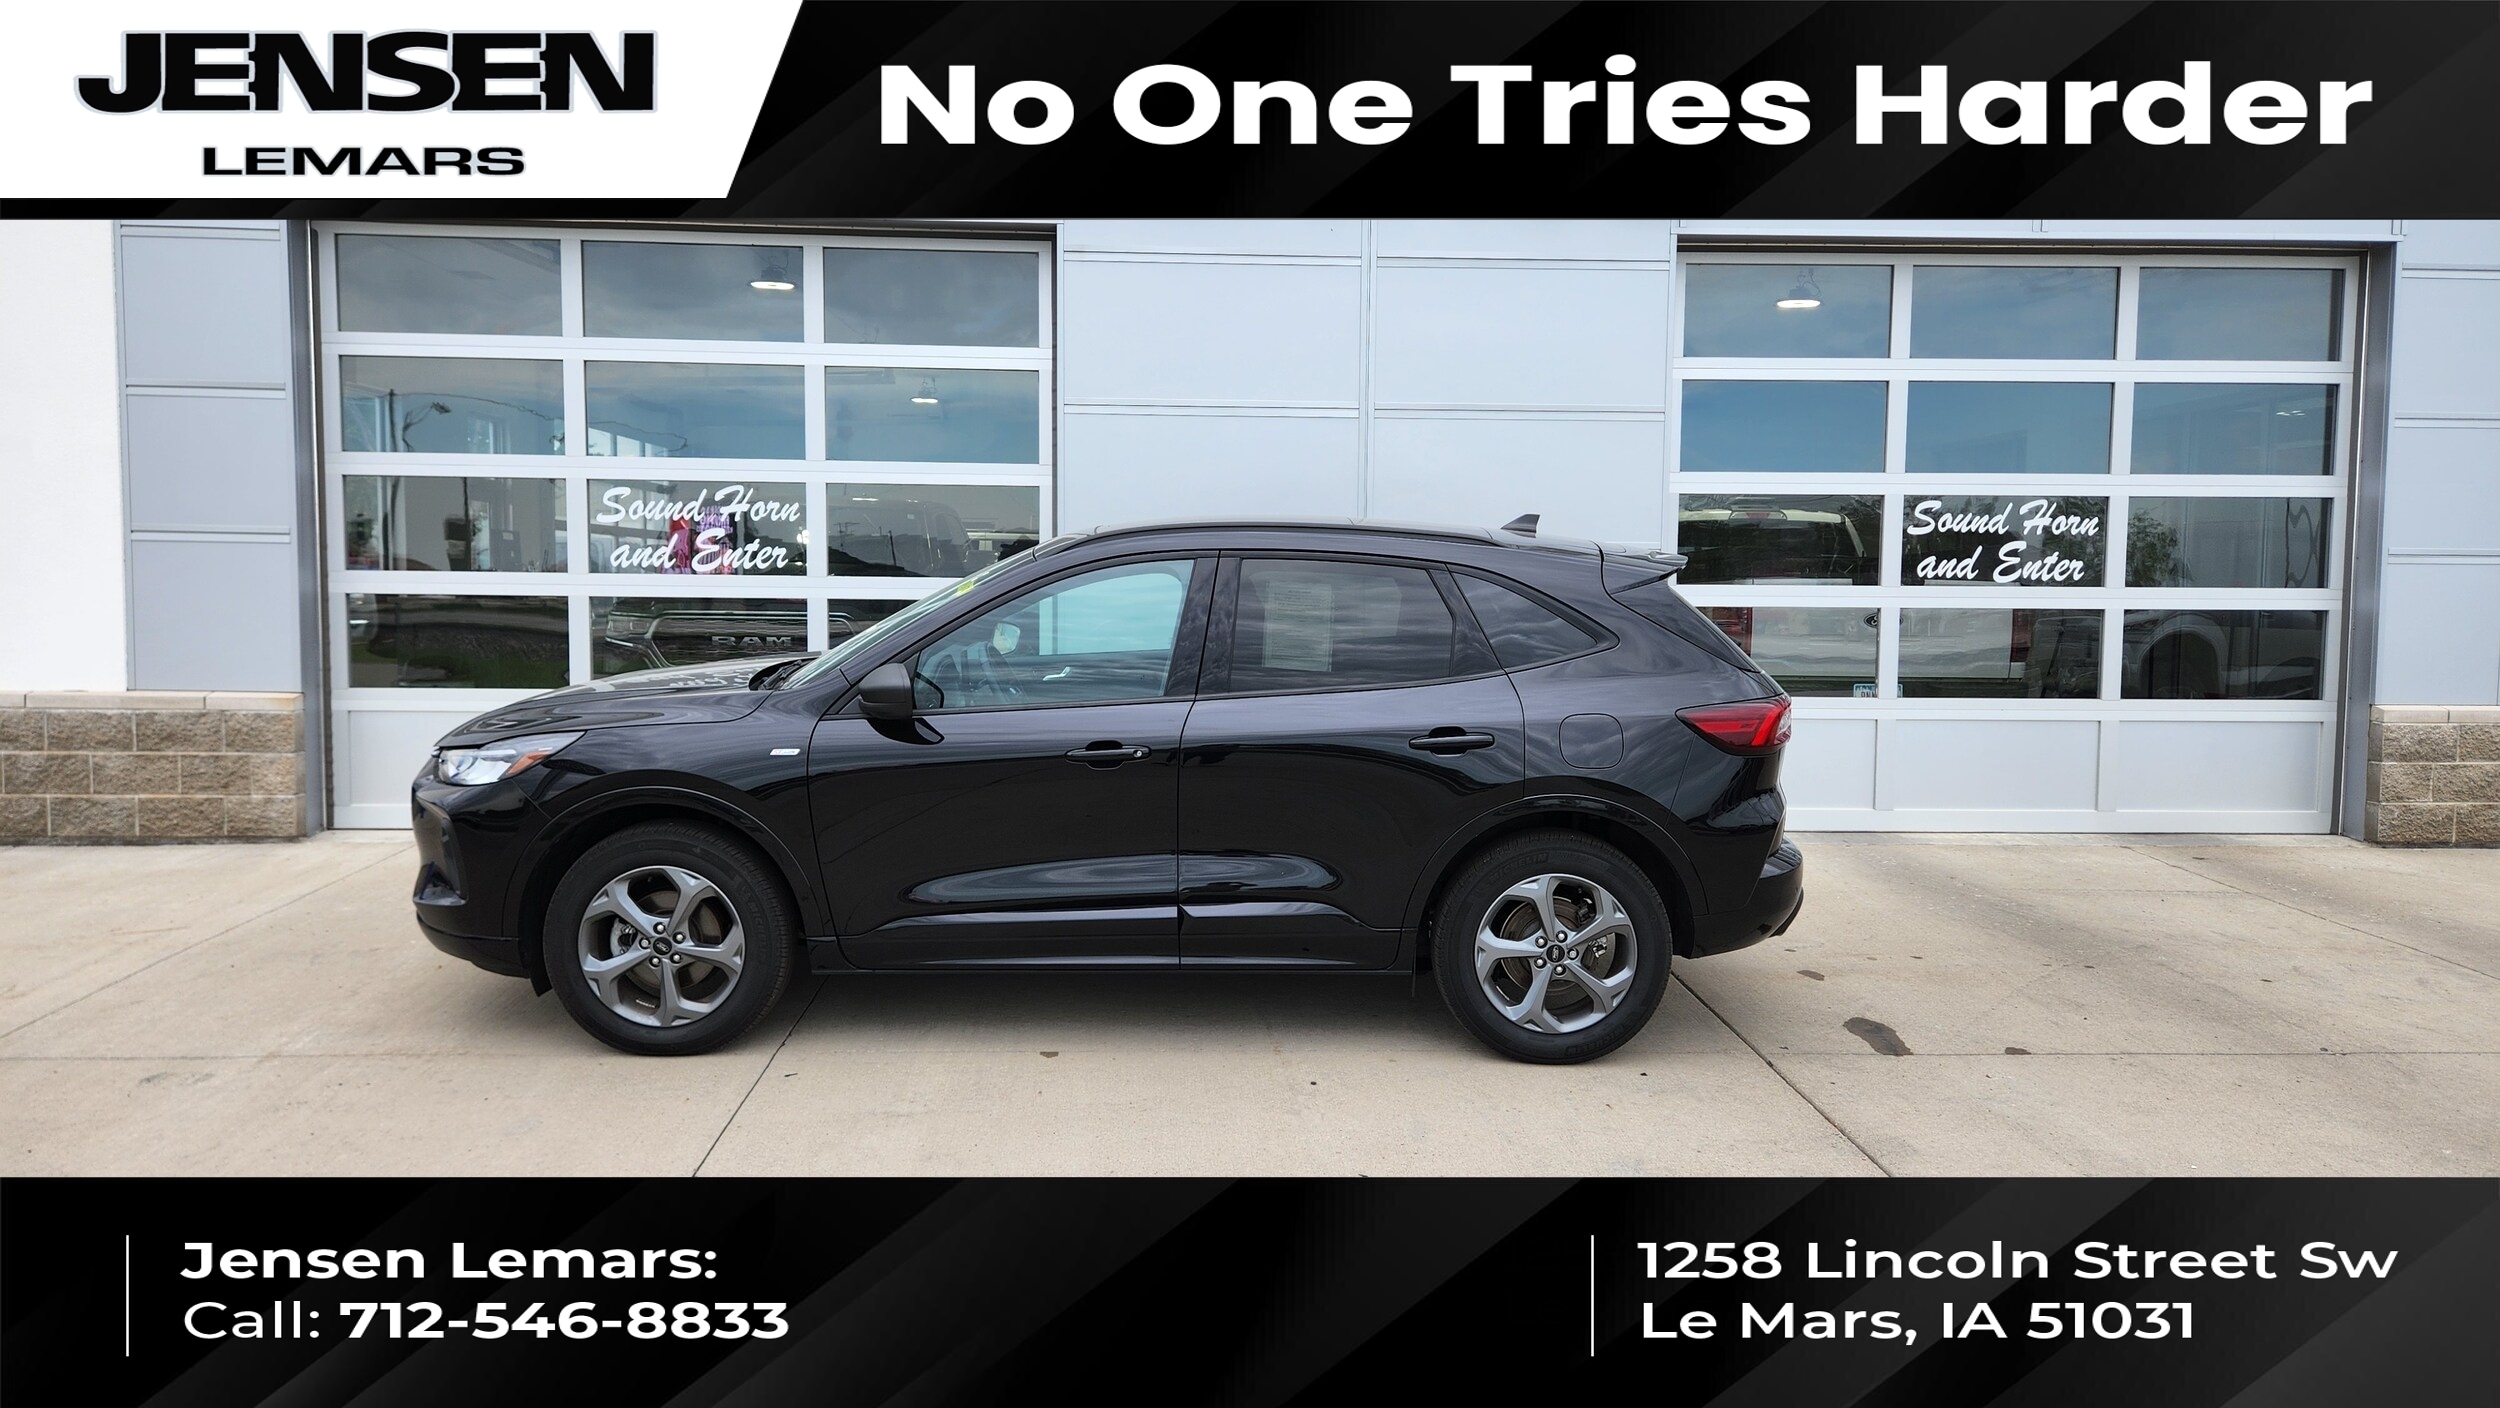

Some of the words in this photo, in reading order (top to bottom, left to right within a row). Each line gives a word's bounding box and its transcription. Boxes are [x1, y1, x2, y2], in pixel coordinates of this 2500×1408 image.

[596, 486, 707, 523] Sound
[714, 485, 800, 522] Horn
[1907, 500, 2013, 535] Sound
[2019, 499, 2100, 536] Horn
[610, 533, 679, 569] and
[691, 528, 789, 572] Enter
[1917, 545, 1983, 579] and
[1993, 540, 2085, 583] Enter
[711, 635, 791, 647] RAM
